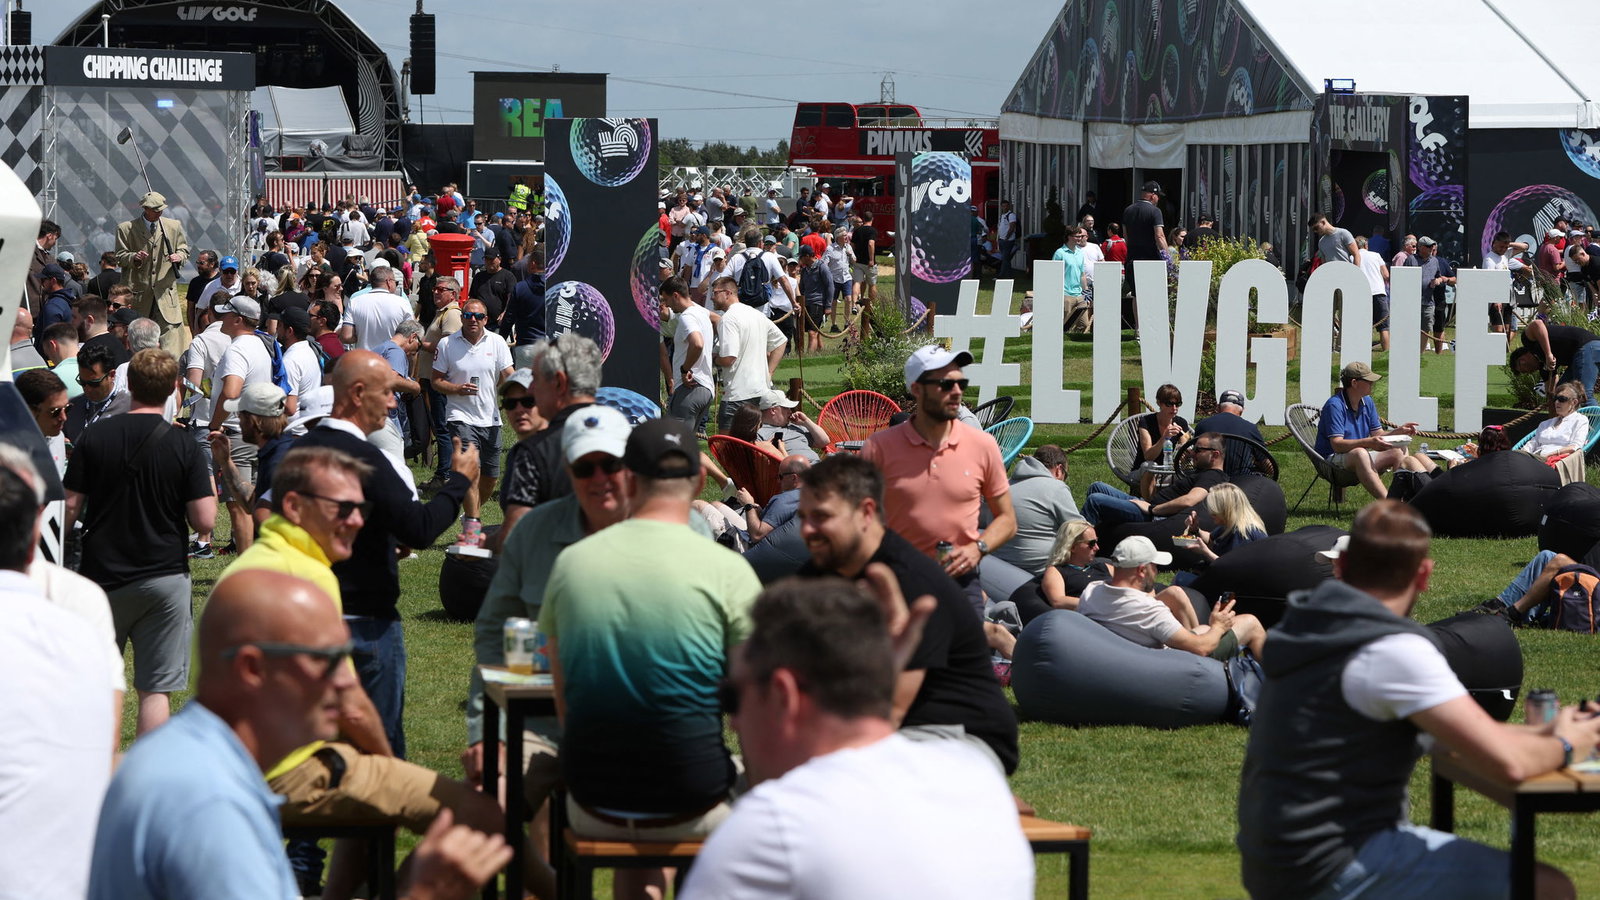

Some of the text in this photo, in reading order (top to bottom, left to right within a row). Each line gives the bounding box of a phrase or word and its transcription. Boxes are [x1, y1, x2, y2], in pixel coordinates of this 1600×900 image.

[83, 55, 222, 82] CHIPPING CHALLENGE
[499, 97, 564, 137] REA
[1329, 105, 1390, 142] THE GALLERY
[867, 130, 932, 156] PIMMS
[934, 259, 1510, 434] #LIVGOLF
